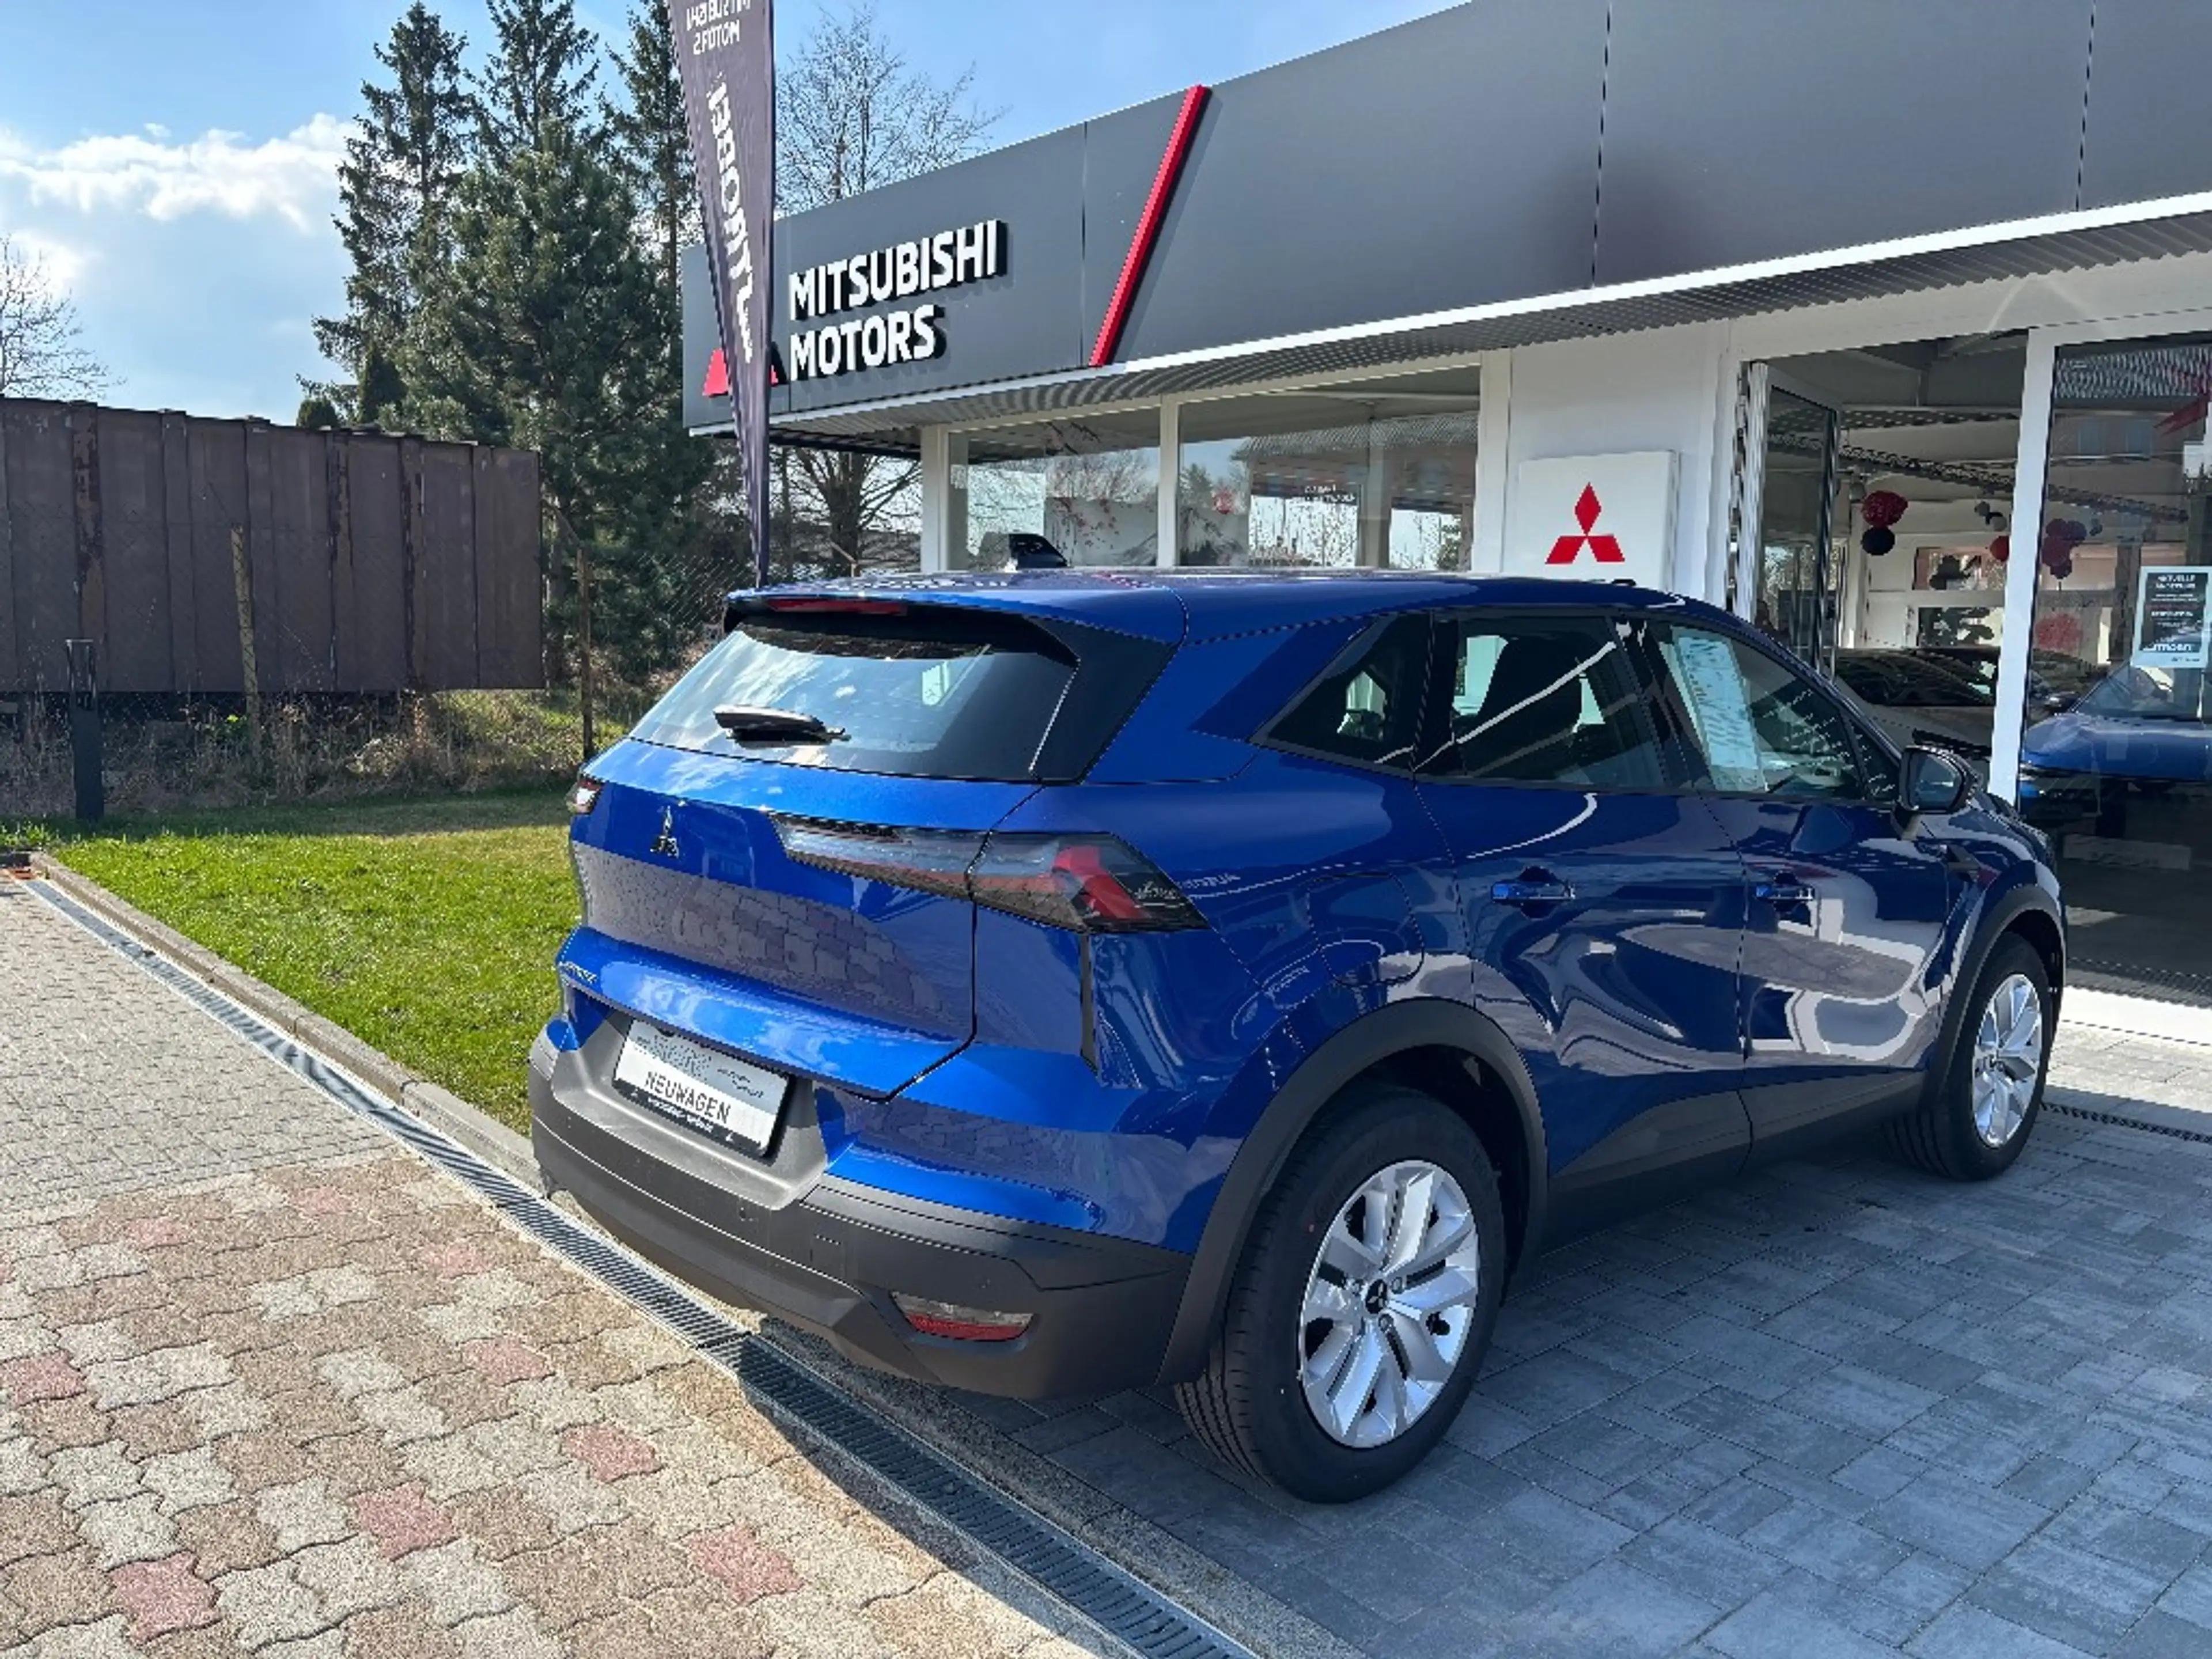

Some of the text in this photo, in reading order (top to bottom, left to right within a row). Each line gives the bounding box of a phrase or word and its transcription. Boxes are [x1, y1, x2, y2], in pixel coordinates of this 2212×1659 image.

[790, 219, 1002, 320] MITSUBISHI
[790, 304, 935, 381] MOTORS
[643, 1070, 732, 1124] NEUWAGEN
